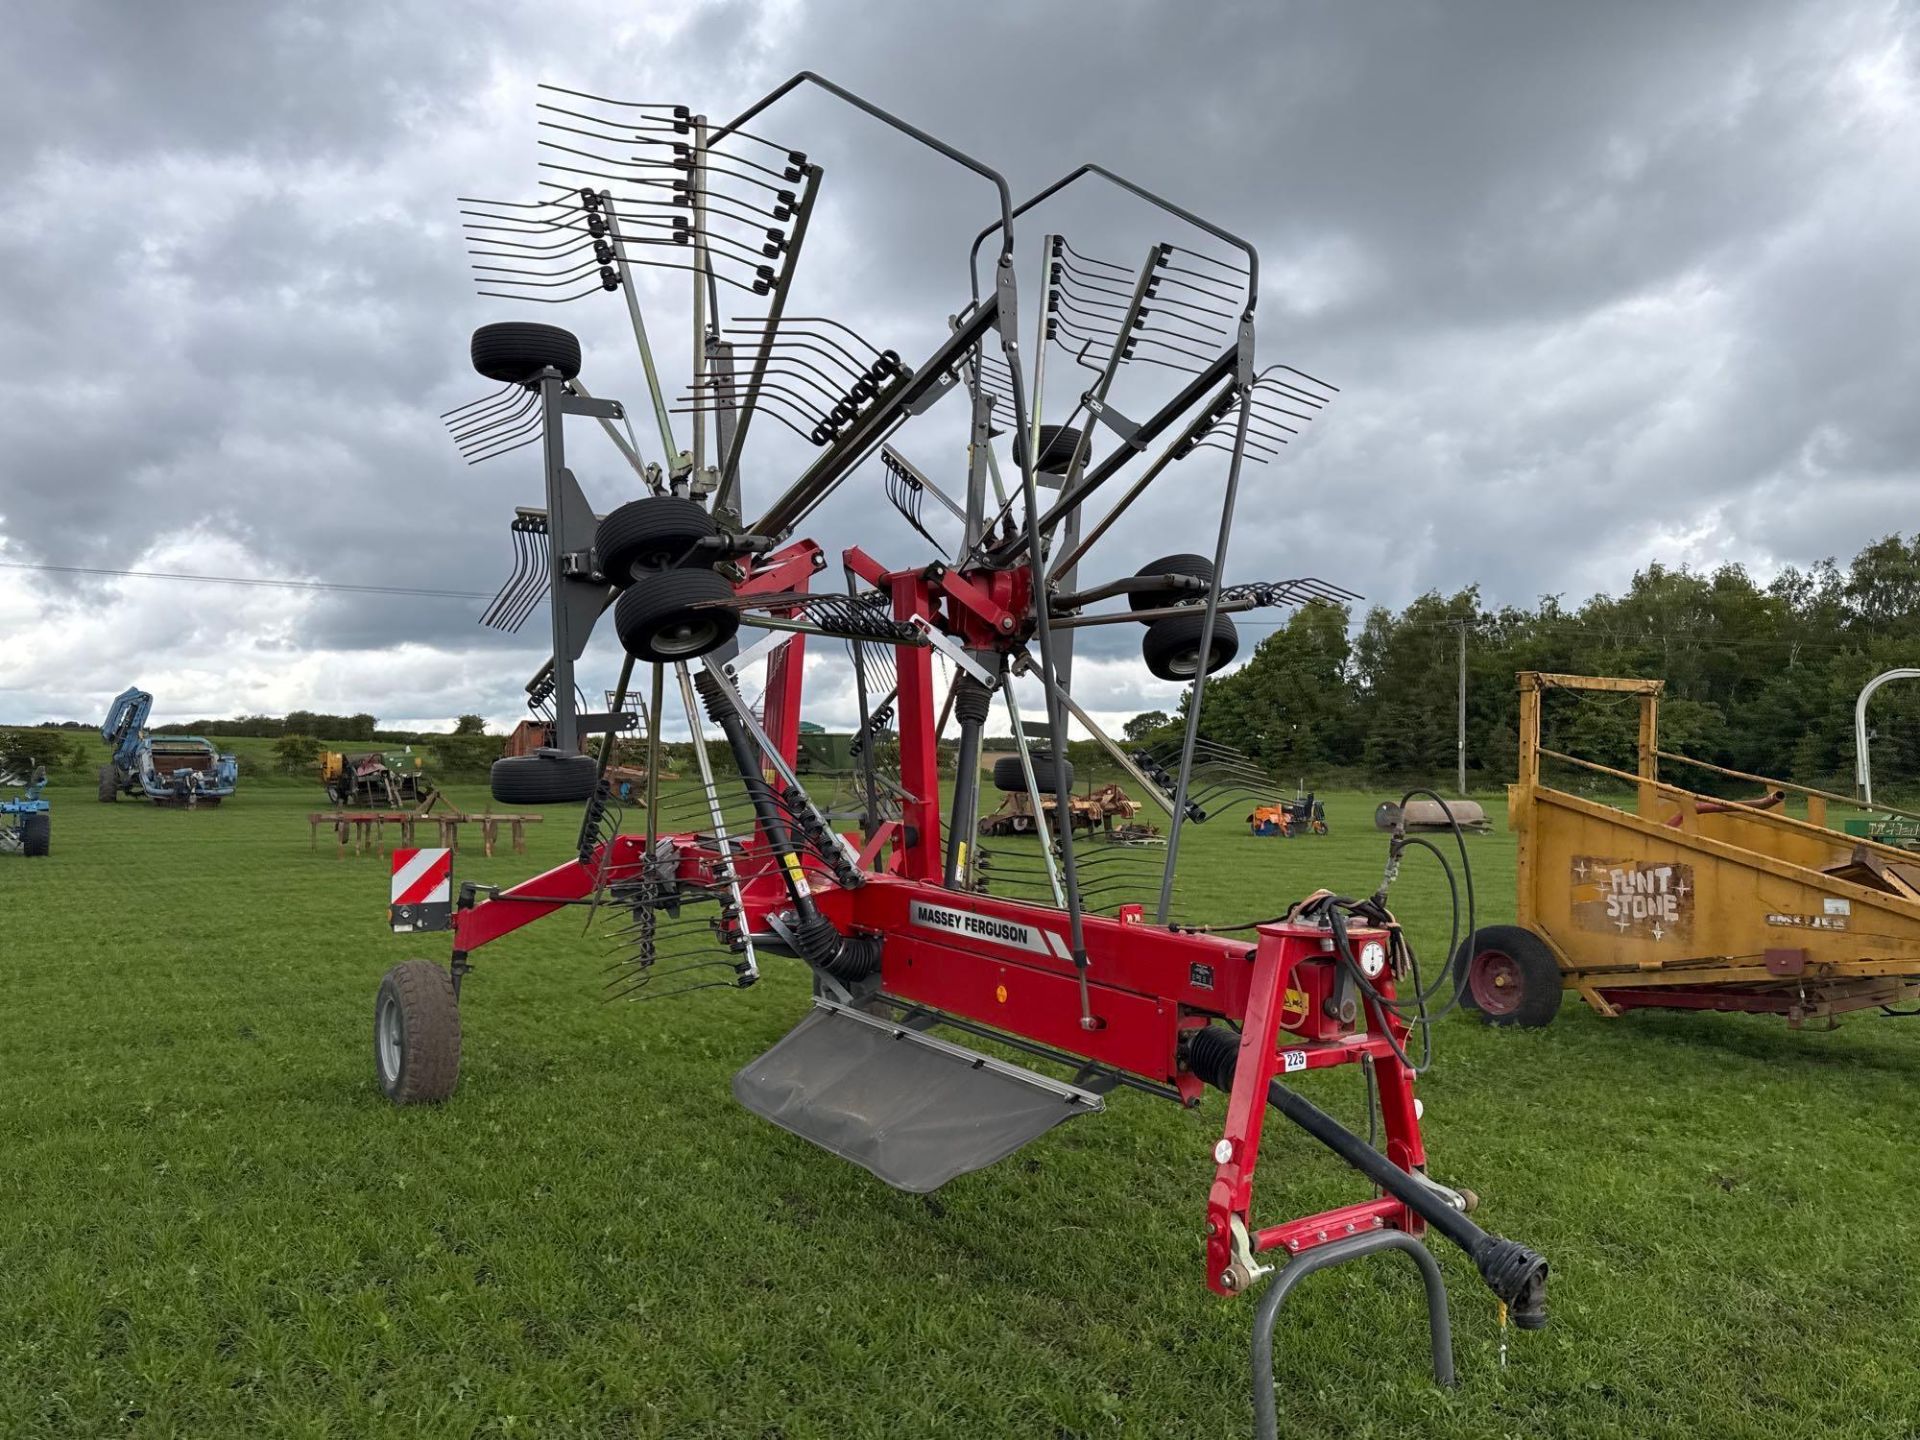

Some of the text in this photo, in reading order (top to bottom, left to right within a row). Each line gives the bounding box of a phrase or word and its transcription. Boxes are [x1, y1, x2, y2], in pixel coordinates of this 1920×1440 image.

[1609, 867, 1672, 893] FLINT
[1606, 894, 1679, 921] STONE
[918, 906, 1028, 944] MASSEY FERGUSON
[1287, 1052, 1304, 1066] 225
